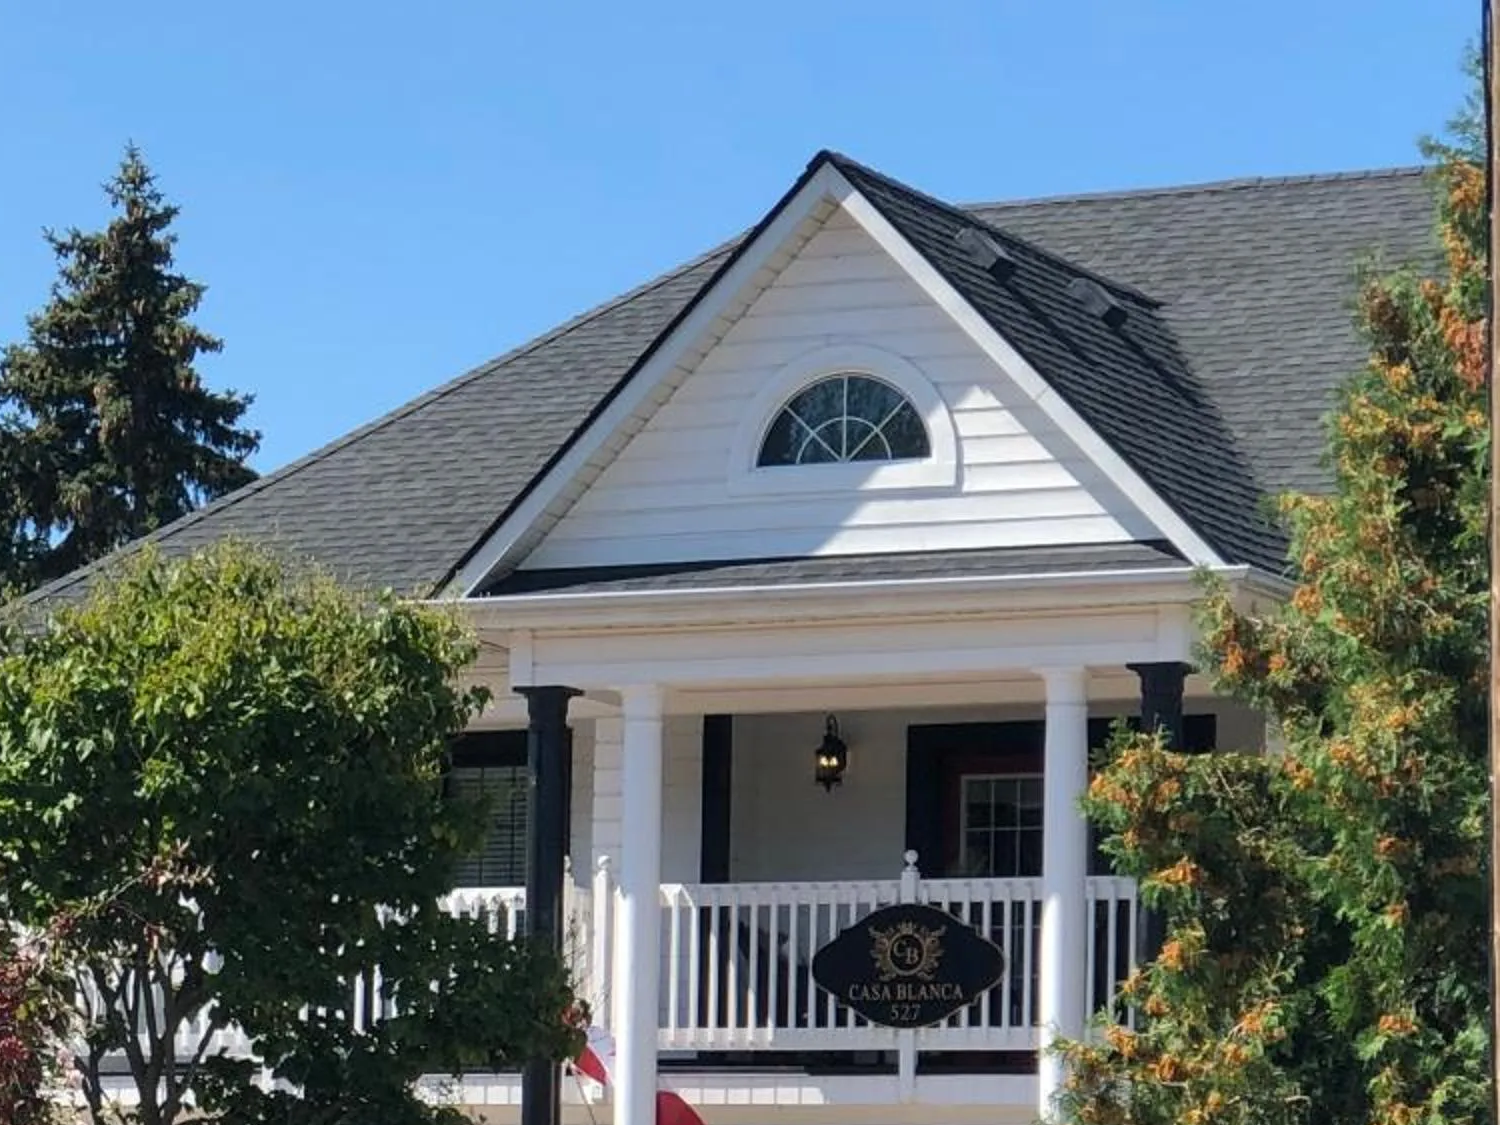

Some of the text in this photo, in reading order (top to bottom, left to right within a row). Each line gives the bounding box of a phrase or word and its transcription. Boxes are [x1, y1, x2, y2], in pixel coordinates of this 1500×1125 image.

[849, 983, 964, 1001] CASA BLANCA
[890, 1003, 921, 1021] 527
